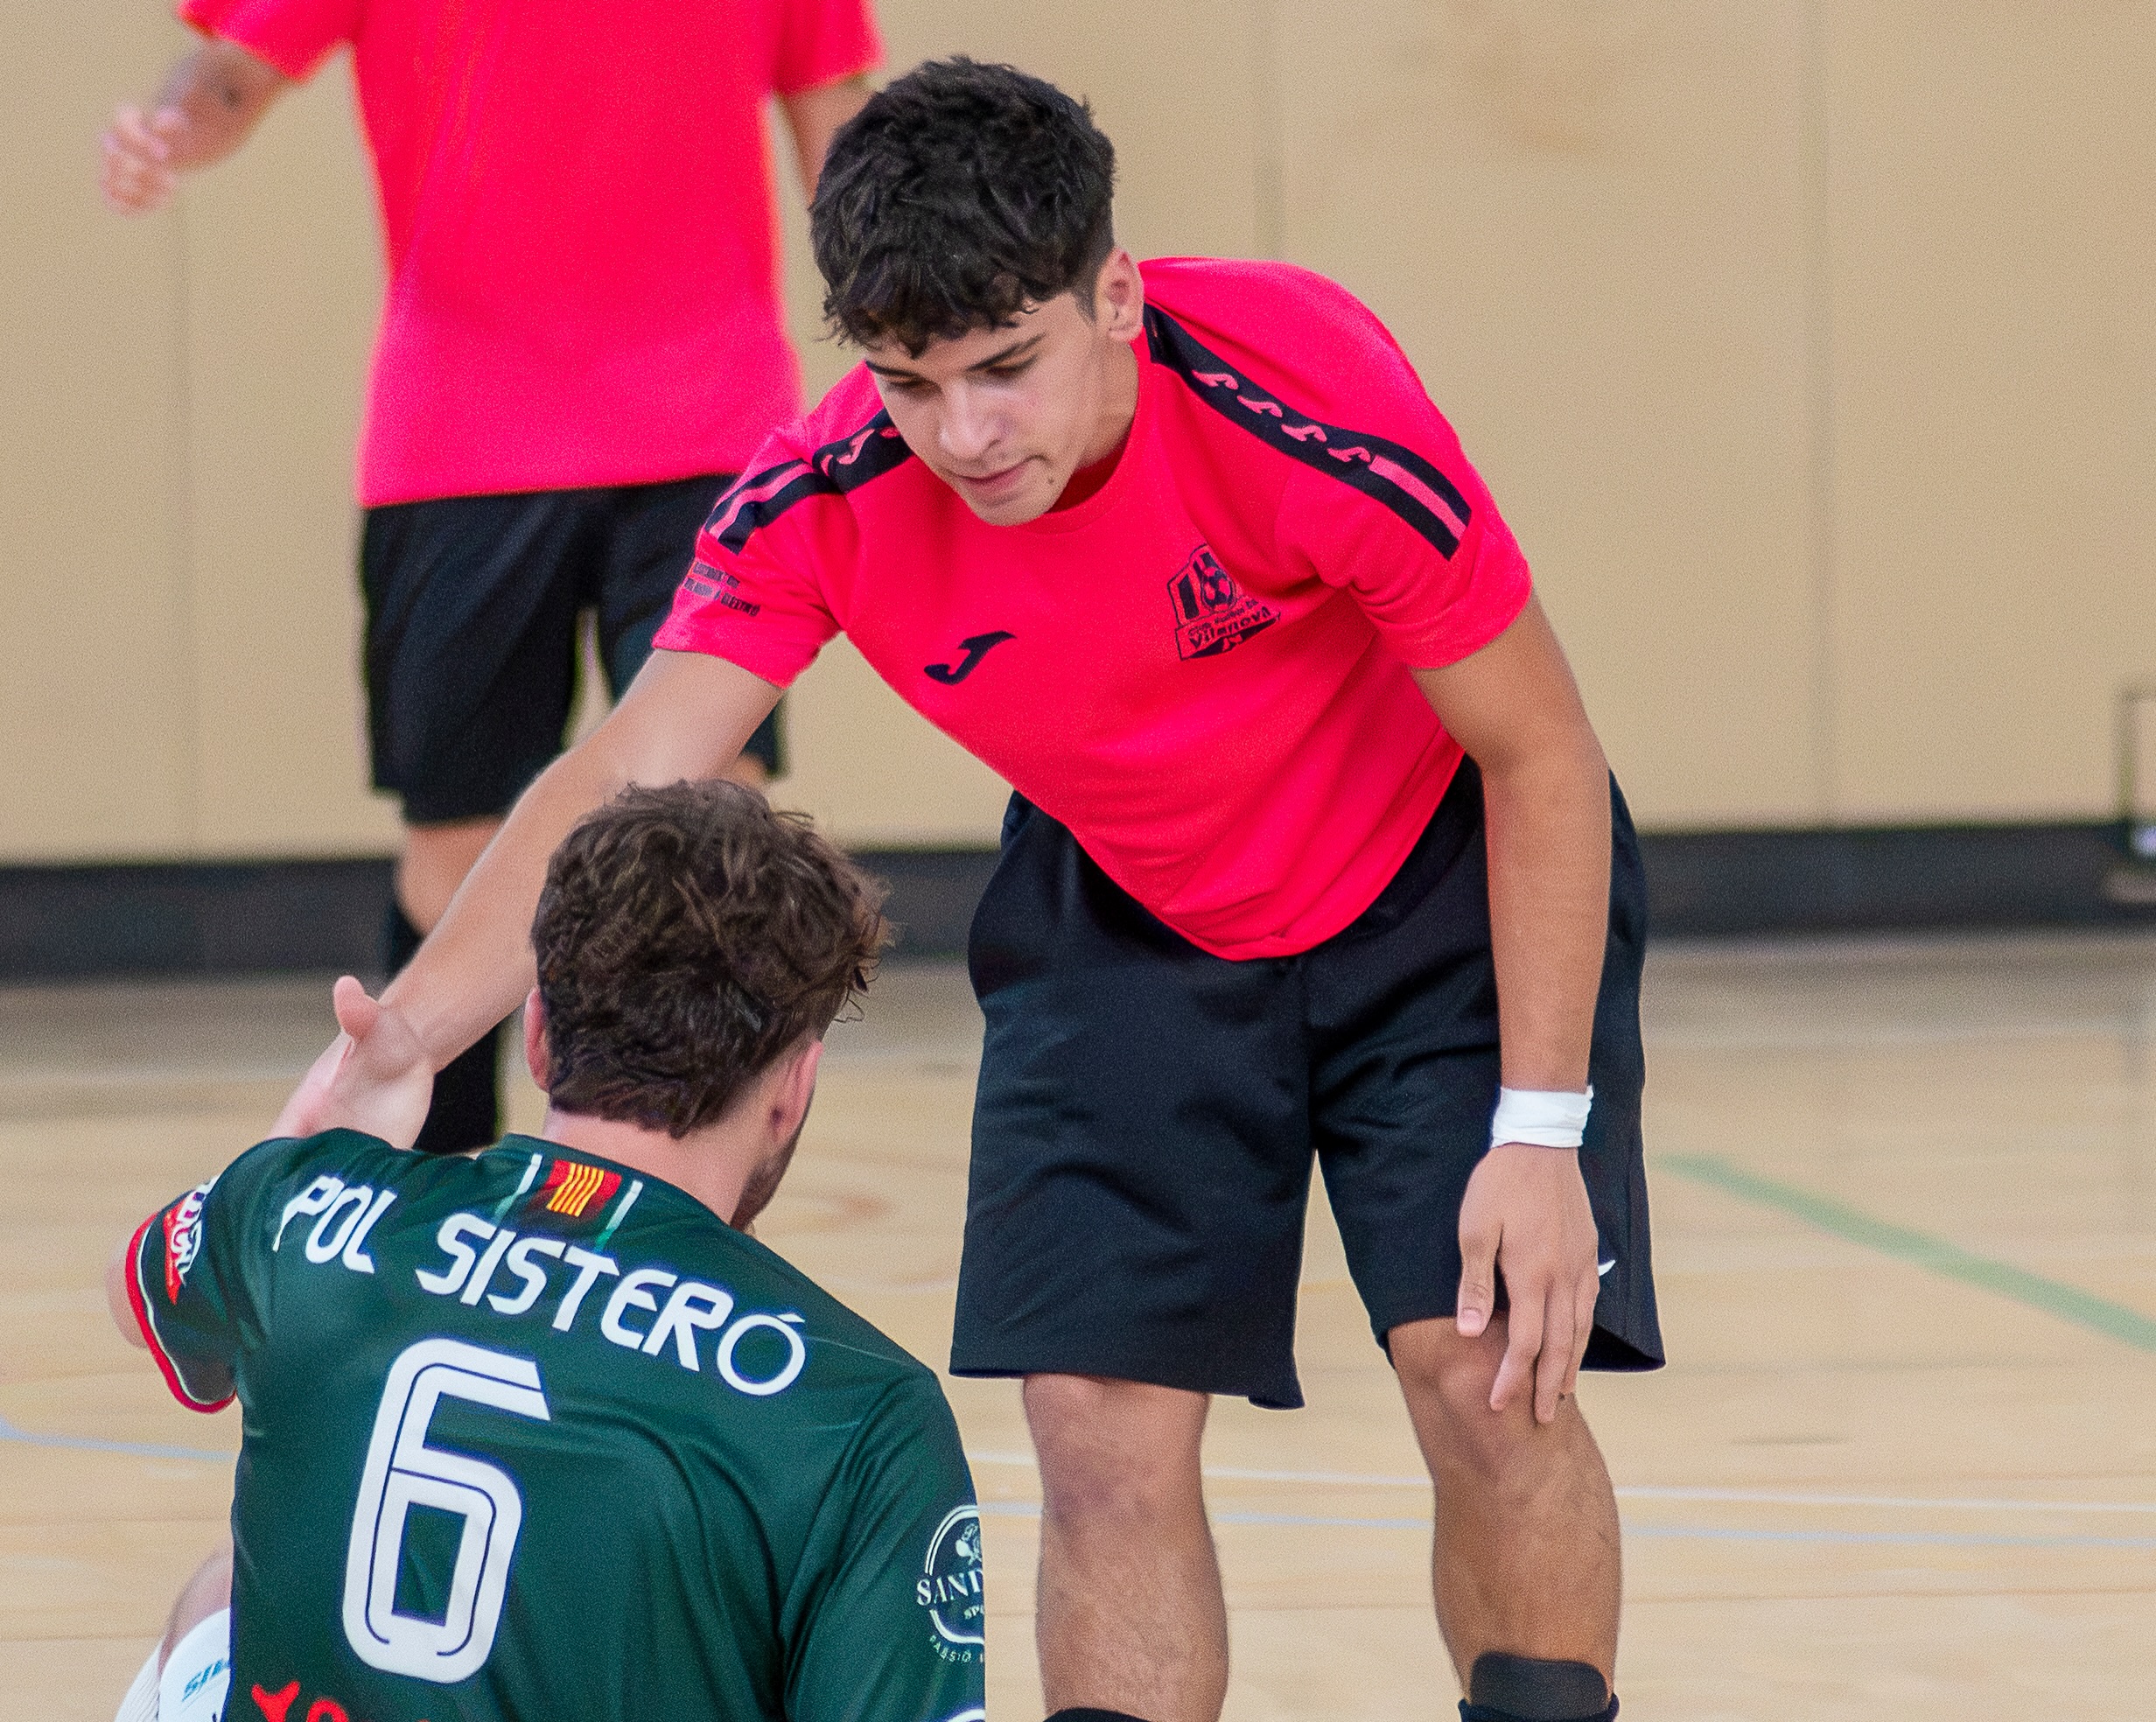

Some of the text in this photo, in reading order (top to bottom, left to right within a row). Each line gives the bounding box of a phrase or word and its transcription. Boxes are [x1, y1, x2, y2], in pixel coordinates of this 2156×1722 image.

[272, 1174, 398, 1275] POL
[415, 1212, 806, 1396] SISTERÓ
[341, 1338, 551, 1684] 6
